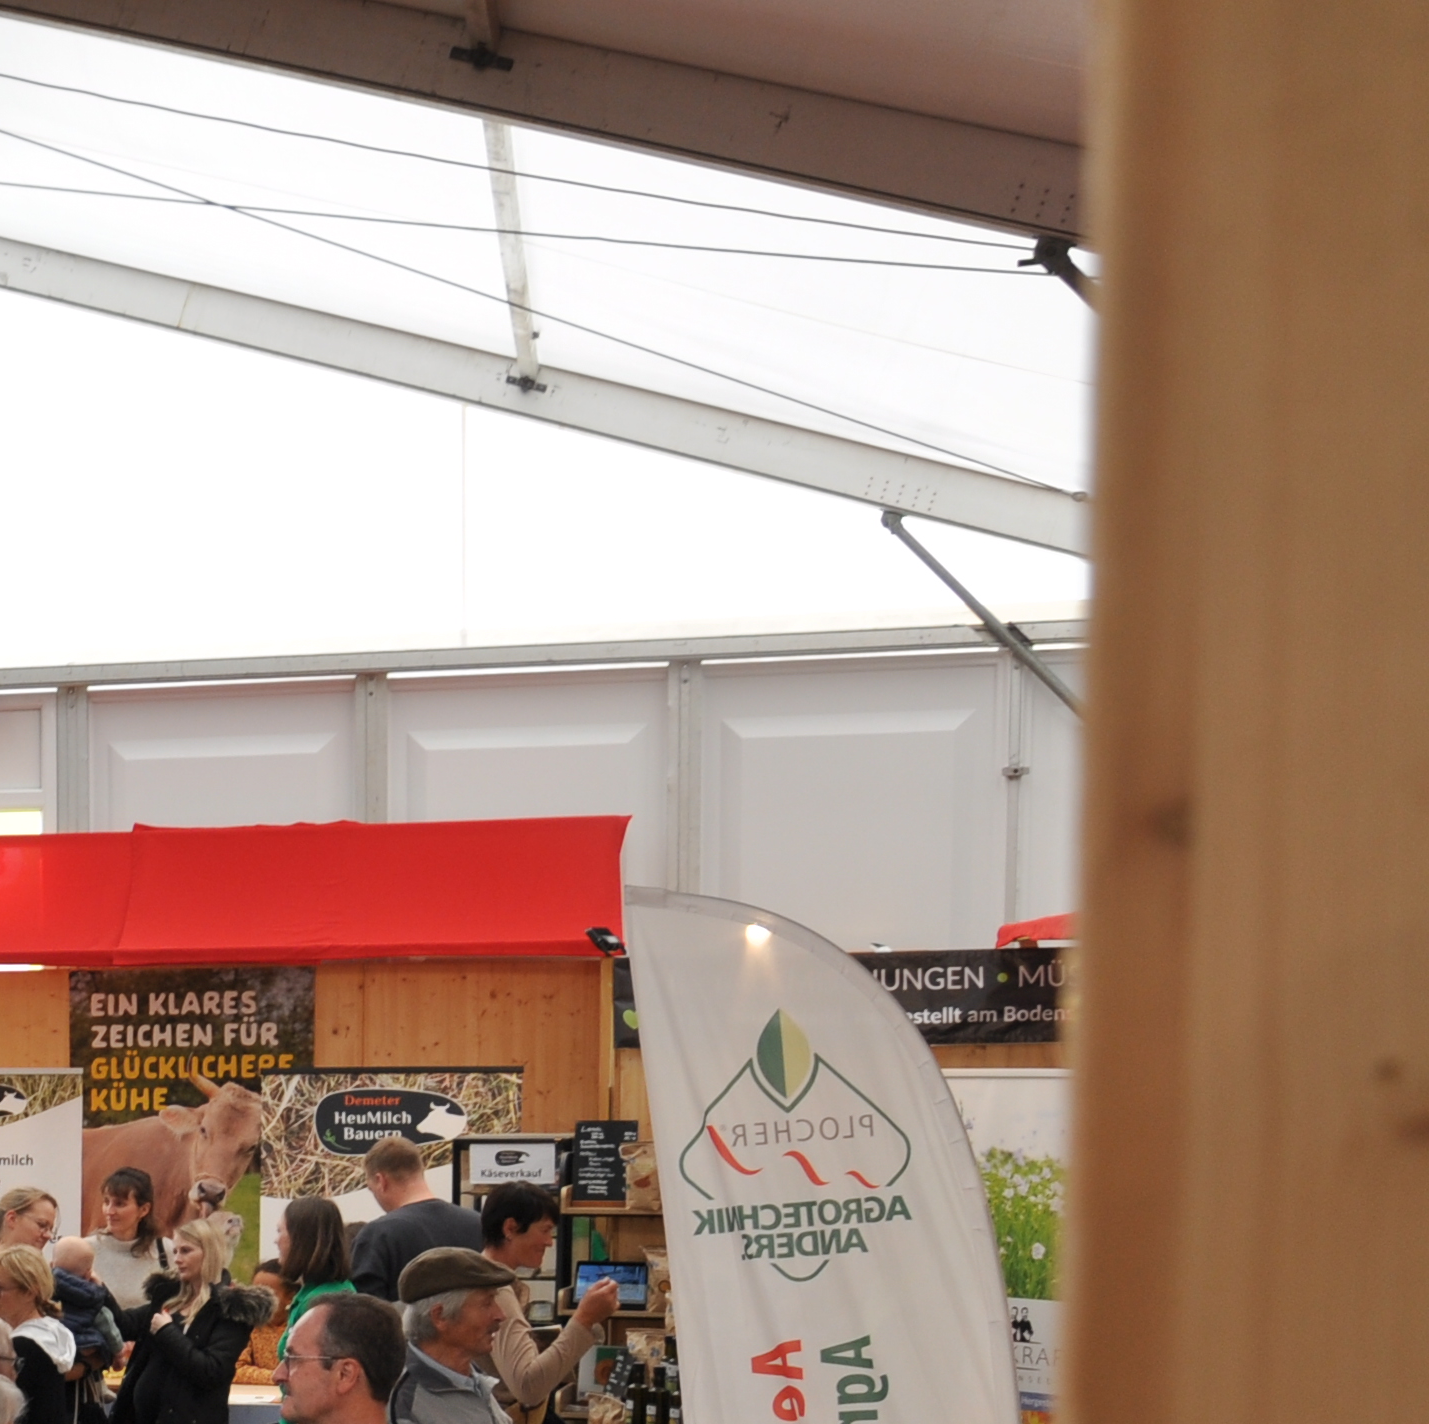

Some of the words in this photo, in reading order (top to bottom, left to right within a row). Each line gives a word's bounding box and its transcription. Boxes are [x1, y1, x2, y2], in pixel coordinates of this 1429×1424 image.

[872, 966, 984, 991] UNGEN
[91, 992, 138, 1017] EIN
[148, 990, 257, 1016] KLARES
[967, 1010, 997, 1022] am
[91, 1022, 213, 1049] ZEICHEN
[224, 1015, 279, 1047] FÜR
[91, 1081, 168, 1112] KÜHE
[344, 1095, 401, 1106] Demeter
[334, 1111, 412, 1126] HeuMilch
[481, 1167, 543, 1179] Käseverkauf
